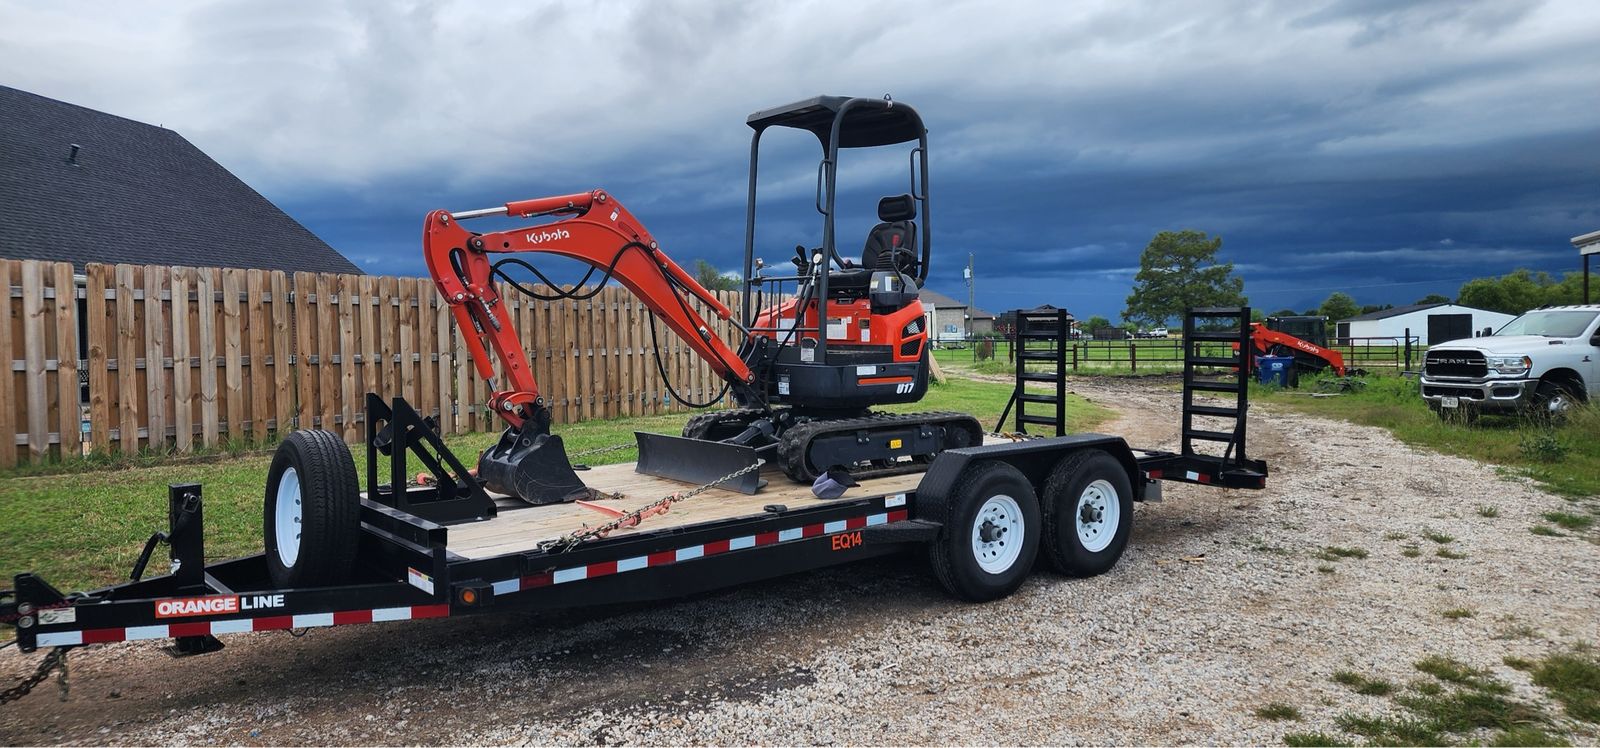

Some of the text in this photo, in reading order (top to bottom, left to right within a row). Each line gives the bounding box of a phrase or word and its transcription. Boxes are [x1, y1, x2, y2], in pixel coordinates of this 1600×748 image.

[526, 229, 570, 244] Kubota
[896, 382, 915, 394] U17
[832, 531, 862, 550] EQ14
[158, 594, 285, 615] ORANGE LINE
